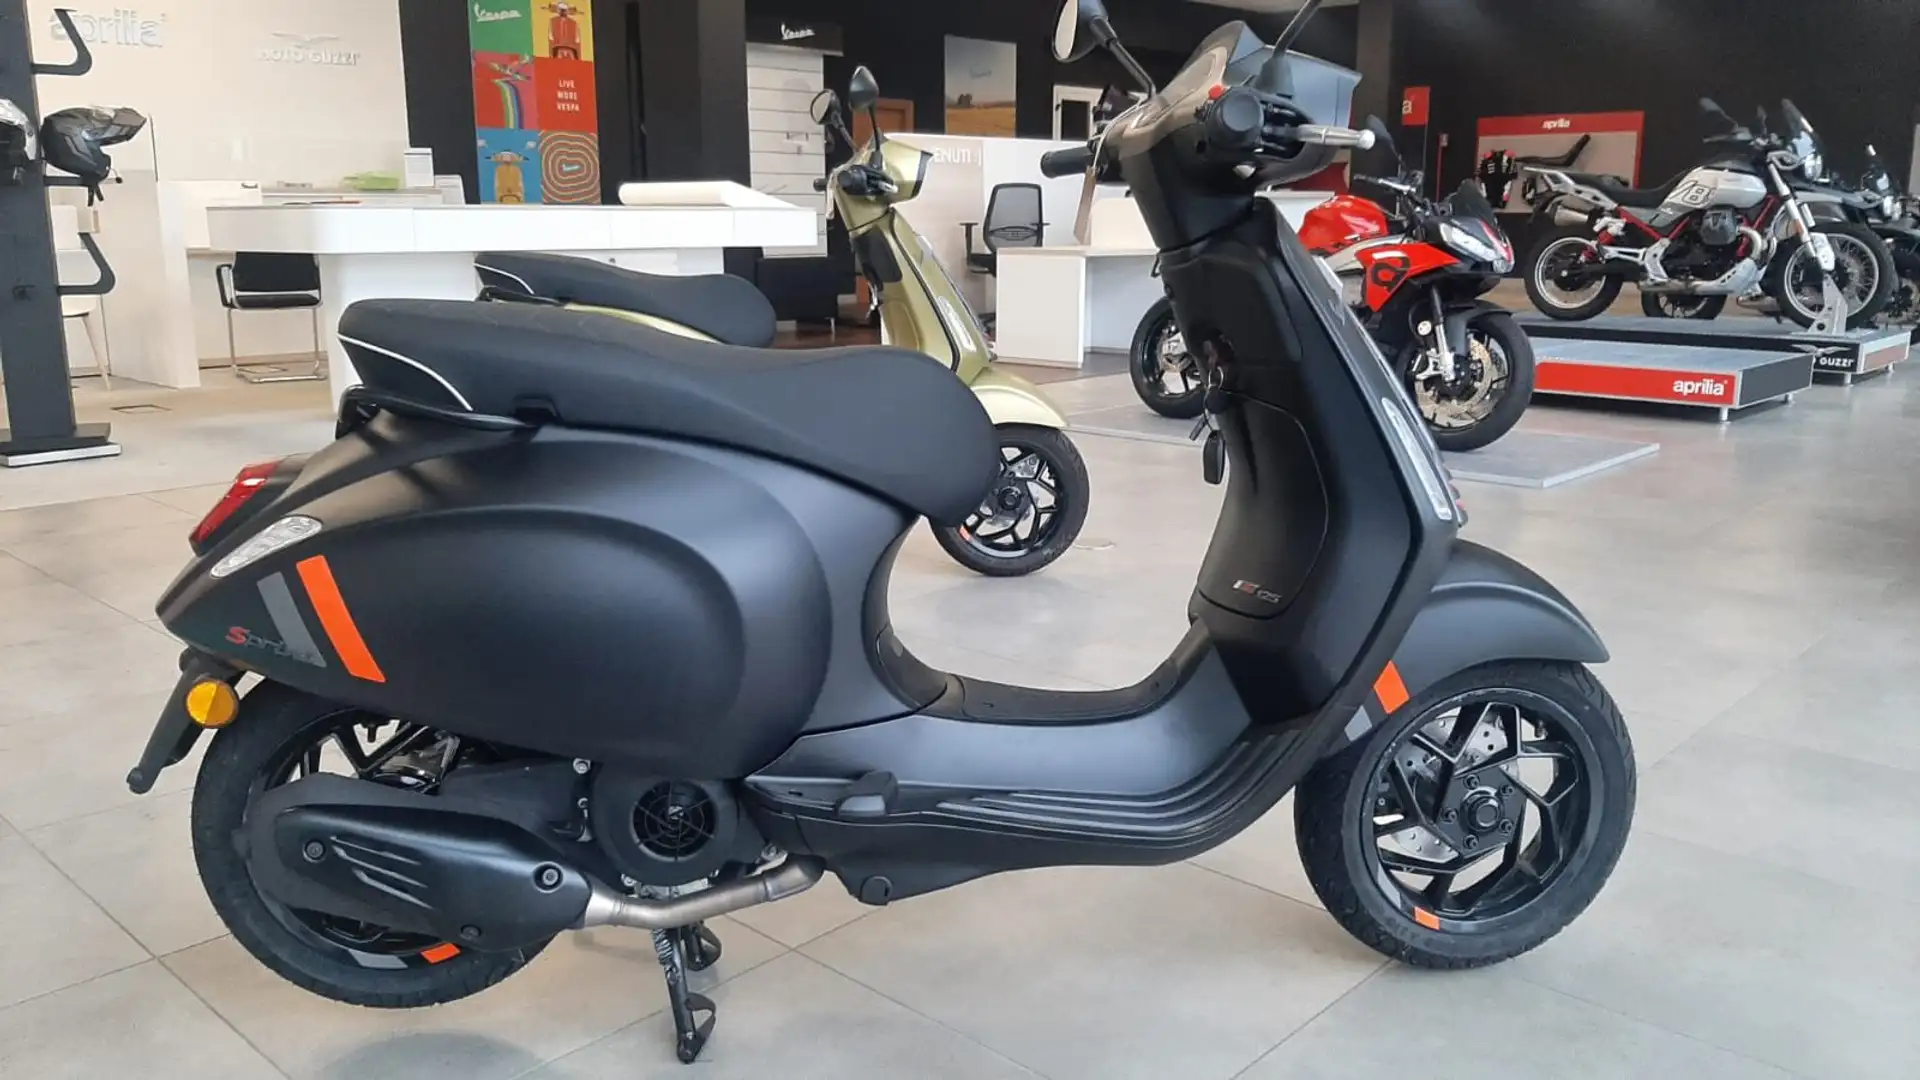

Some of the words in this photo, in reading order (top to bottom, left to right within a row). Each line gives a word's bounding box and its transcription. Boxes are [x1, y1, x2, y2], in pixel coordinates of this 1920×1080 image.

[558, 79, 575, 89] LIVE
[933, 147, 971, 165] ENUTI
[1672, 378, 1726, 396] aprilia
